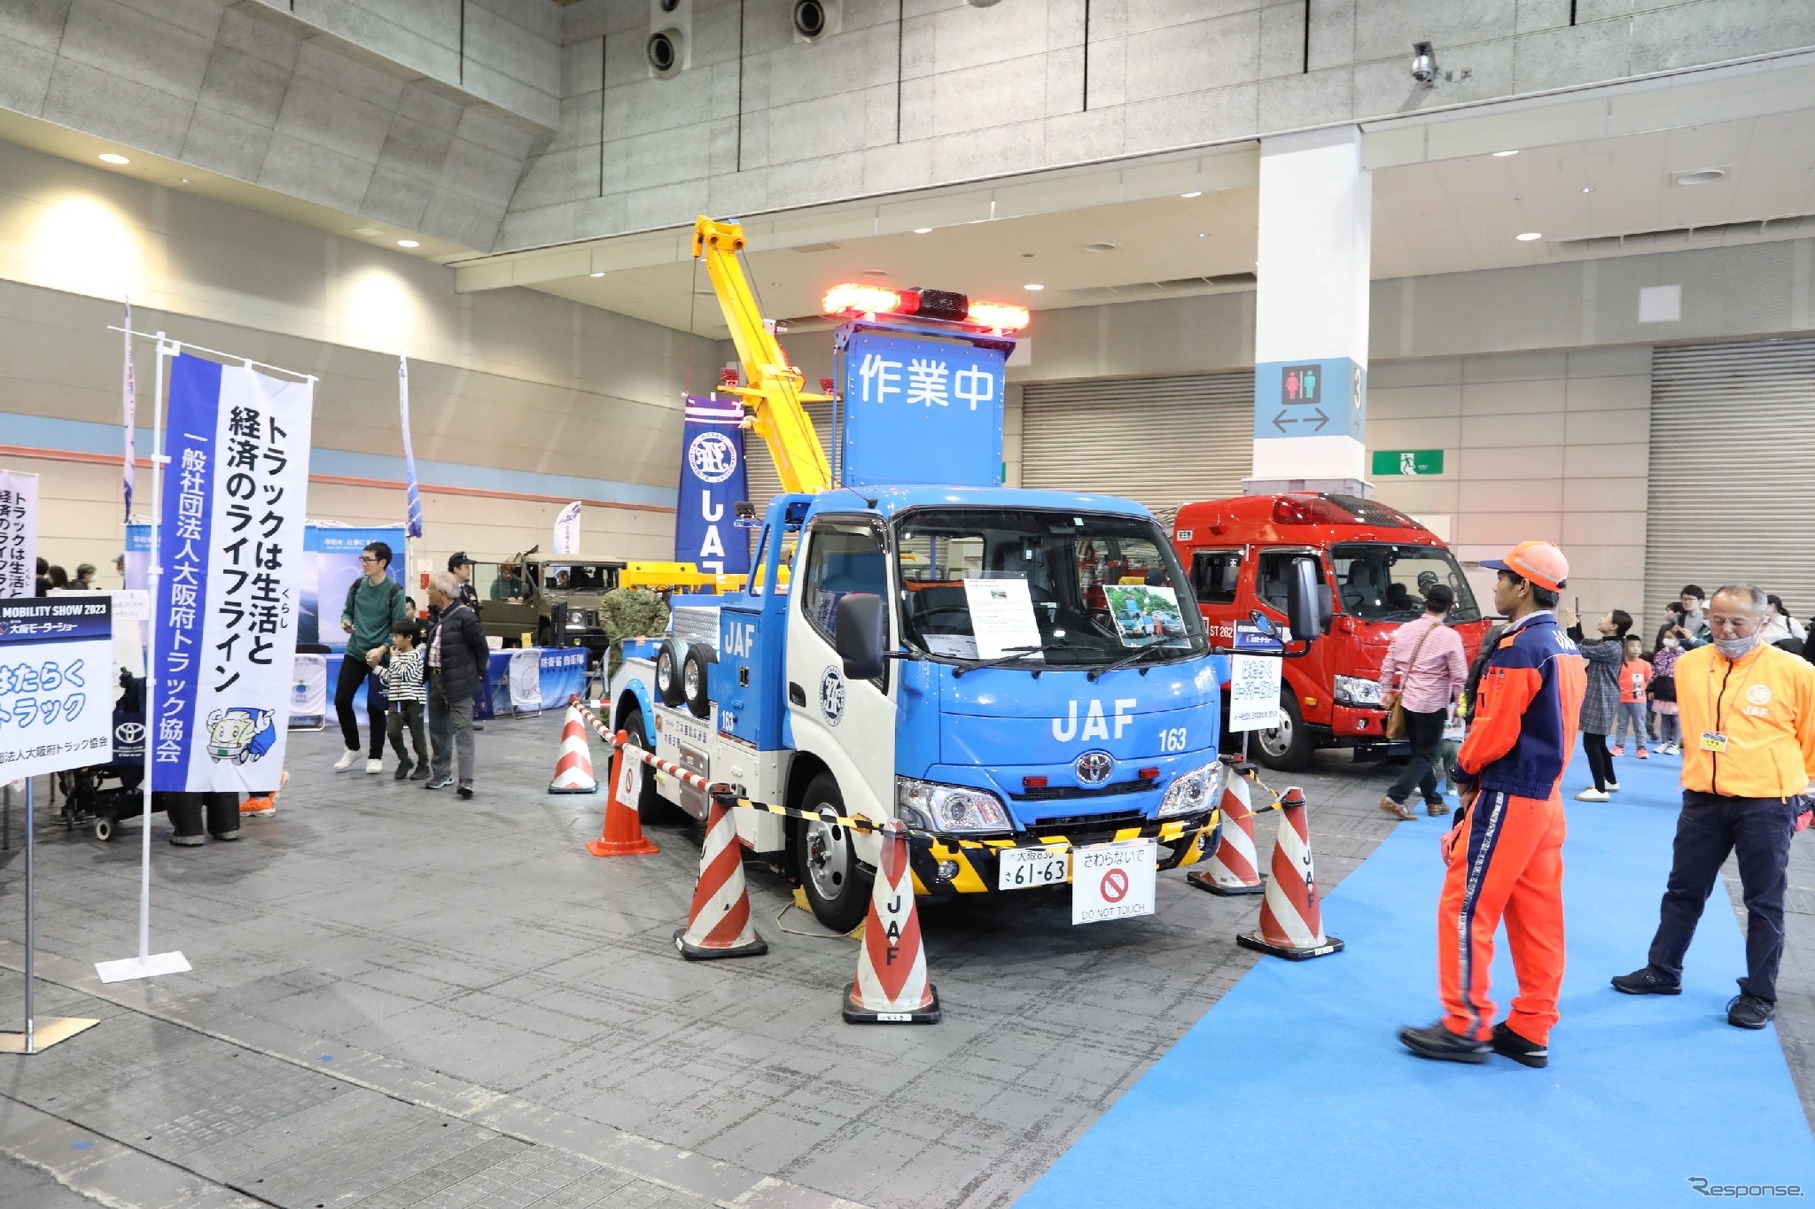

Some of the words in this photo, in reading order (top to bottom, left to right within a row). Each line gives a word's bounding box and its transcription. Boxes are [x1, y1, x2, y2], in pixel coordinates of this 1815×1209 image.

[859, 353, 994, 411] 作業中
[1354, 368, 1361, 409] 3
[214, 405, 261, 693] 経済のライフライン
[248, 416, 288, 665] トラックは生活と
[3, 606, 51, 618] MOBILITY
[52, 604, 83, 616] SHOW
[84, 604, 107, 615] 2023
[156, 432, 209, 764] 一般社団法人大阪府トラック協会
[280, 587, 290, 629] くらし
[725, 621, 755, 659] JAF
[1210, 625, 1219, 637] ST
[722, 709, 734, 733] 163
[1052, 698, 1137, 742] JAF
[1742, 705, 1769, 718] JAF
[1159, 728, 1187, 752] 163
[1005, 872, 1011, 882] さ
[1015, 860, 1065, 885] 61-63
[1084, 849, 1145, 868] さわらないで
[1302, 850, 1316, 909] JAF
[886, 895, 901, 966] JAF
[1081, 910, 1095, 920] DO
[1097, 907, 1115, 917] NOT
[1117, 903, 1145, 915] TOUCH
